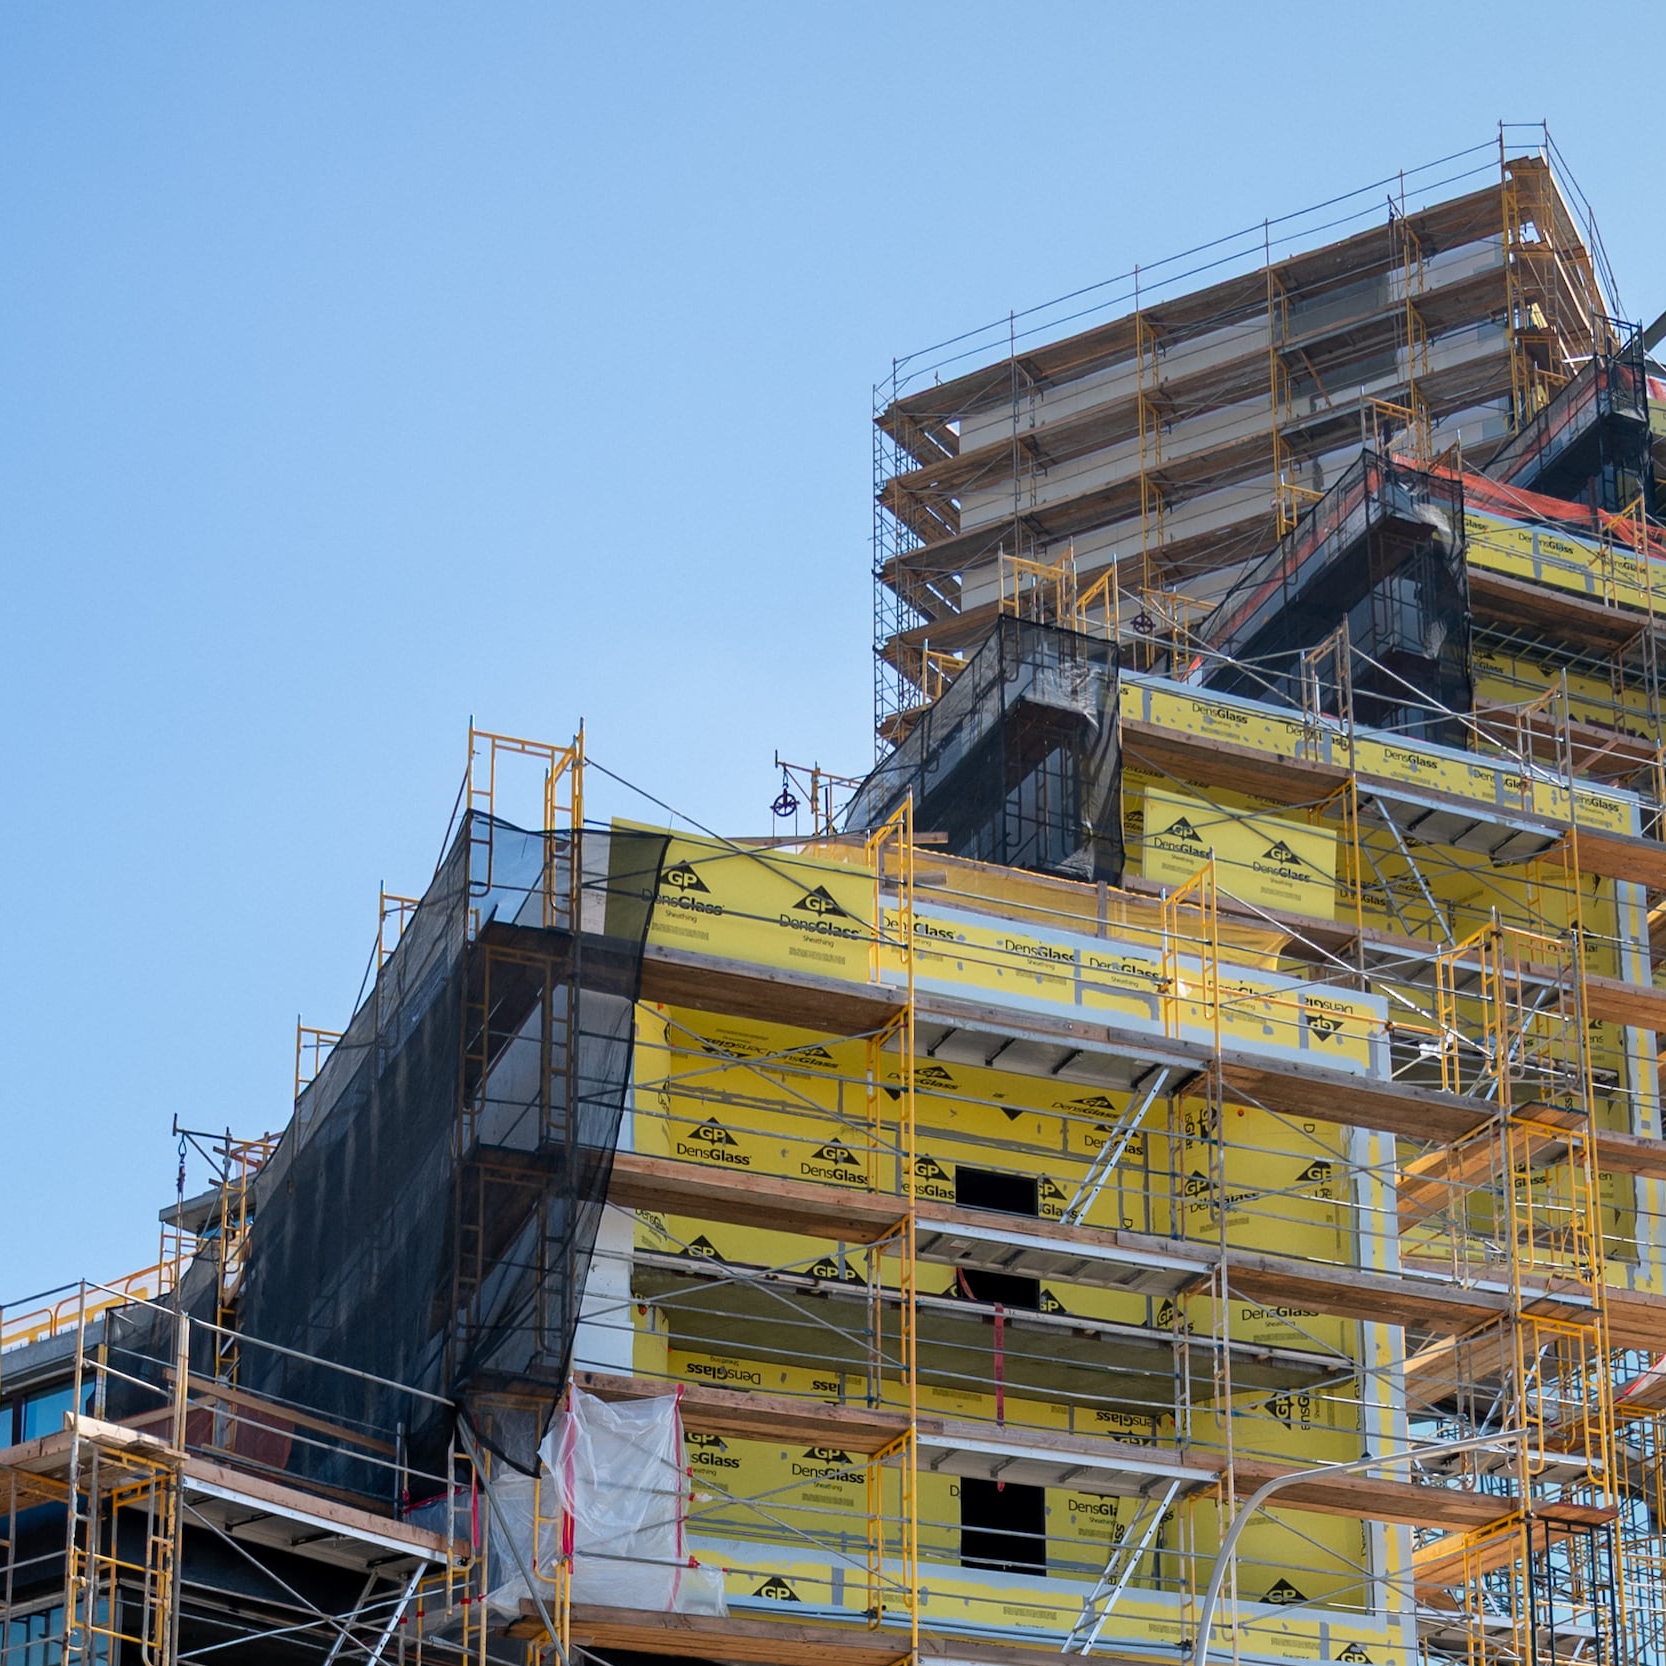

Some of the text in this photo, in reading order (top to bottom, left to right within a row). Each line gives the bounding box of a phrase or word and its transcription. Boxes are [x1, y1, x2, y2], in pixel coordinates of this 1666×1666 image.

[1192, 702, 1248, 725] DensGlass
[1384, 748, 1438, 770] DensGlass
[1172, 824, 1194, 837] GP
[1270, 847, 1293, 861] GP
[667, 869, 698, 889] GP
[805, 896, 835, 913] GP
[779, 913, 861, 940] DensGlass
[1081, 1097, 1110, 1109] GP
[698, 1126, 727, 1143] GP
[676, 1142, 751, 1166] DensGlass
[822, 1148, 849, 1163] GP
[800, 1163, 870, 1185] DensGlass
[914, 1162, 941, 1178] GP
[1184, 1179, 1208, 1195] GP
[684, 1362, 761, 1385] DensGlass
[791, 1462, 866, 1485] DensGlass
[761, 1586, 791, 1601] GP
[1340, 1652, 1366, 1664] GP
